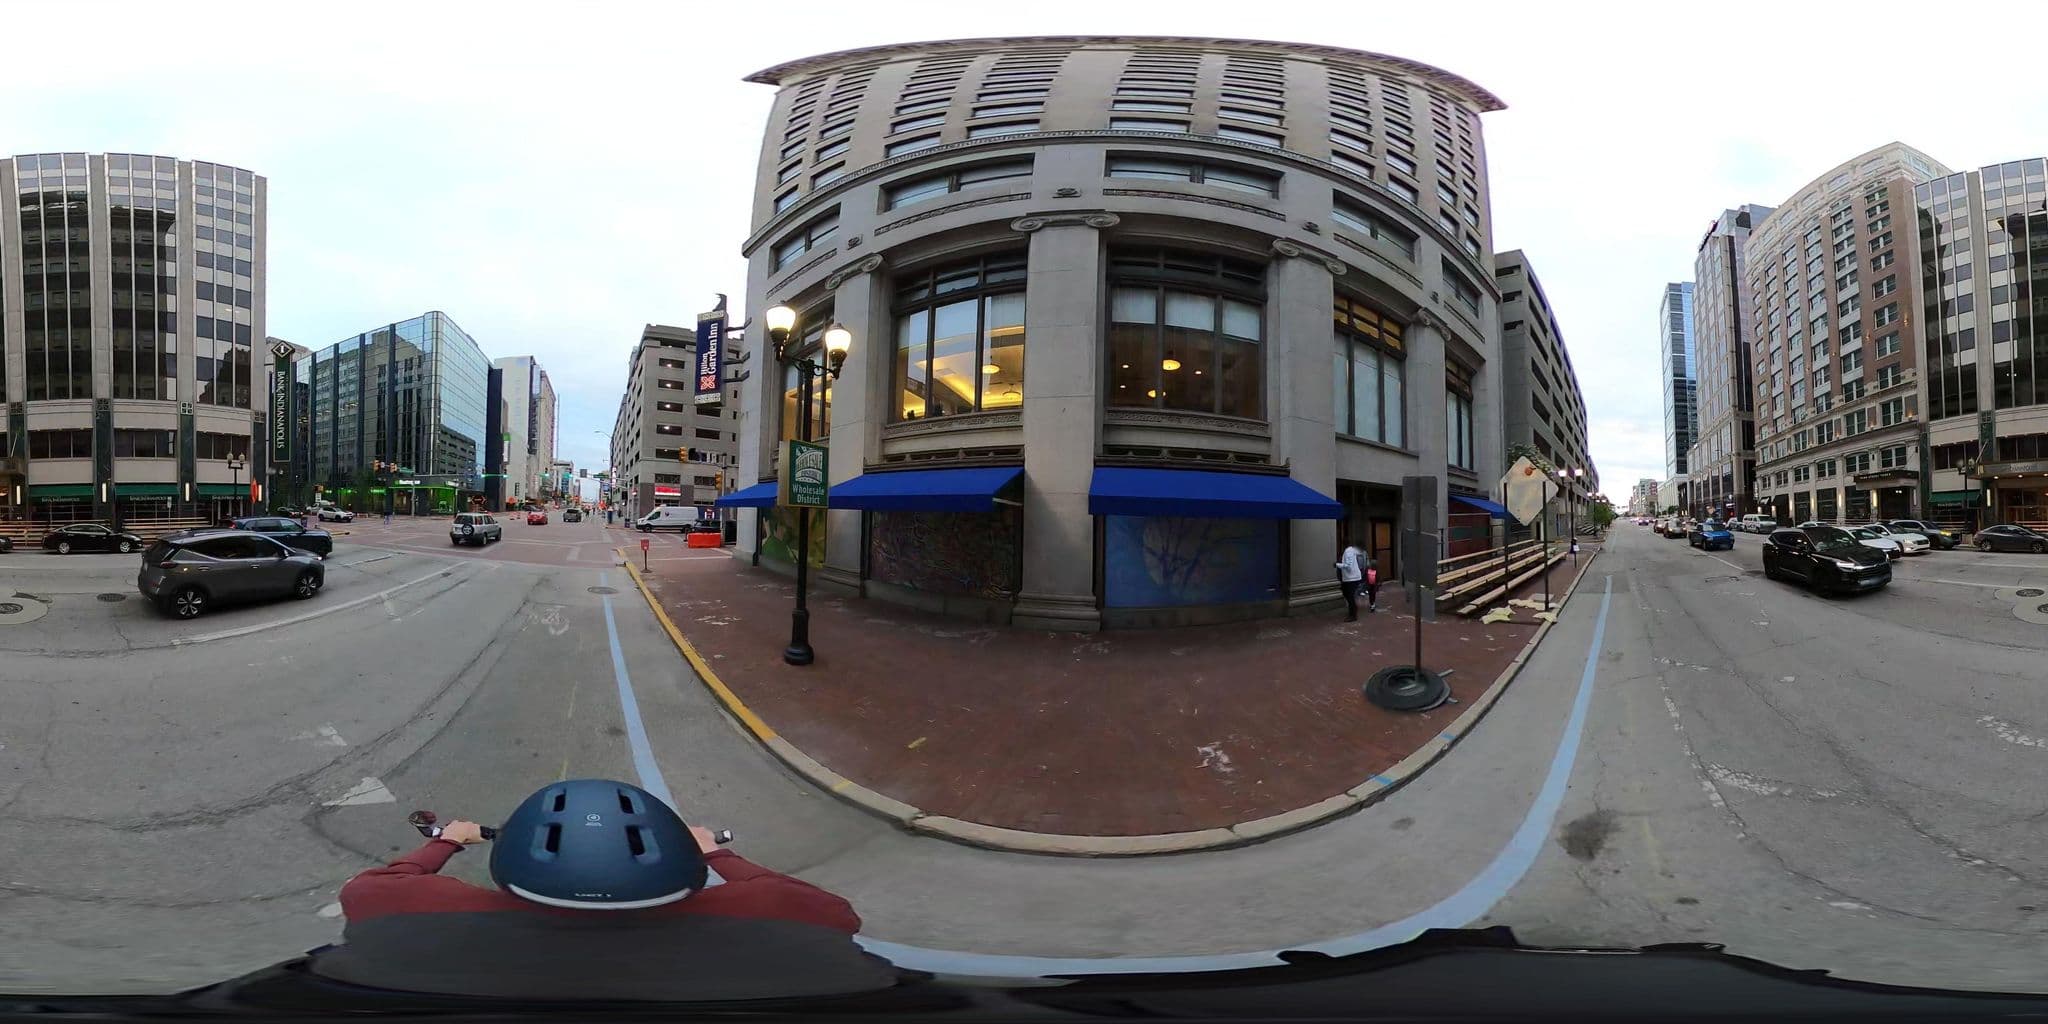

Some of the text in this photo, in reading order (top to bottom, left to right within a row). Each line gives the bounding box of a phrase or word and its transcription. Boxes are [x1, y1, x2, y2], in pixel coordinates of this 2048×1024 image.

[707, 323, 718, 375] Garden Inn
[700, 352, 708, 375] Hilton
[276, 371, 286, 449] BANK INDIANAPOLIS
[792, 484, 825, 496] Wholesale
[797, 494, 820, 504] District
